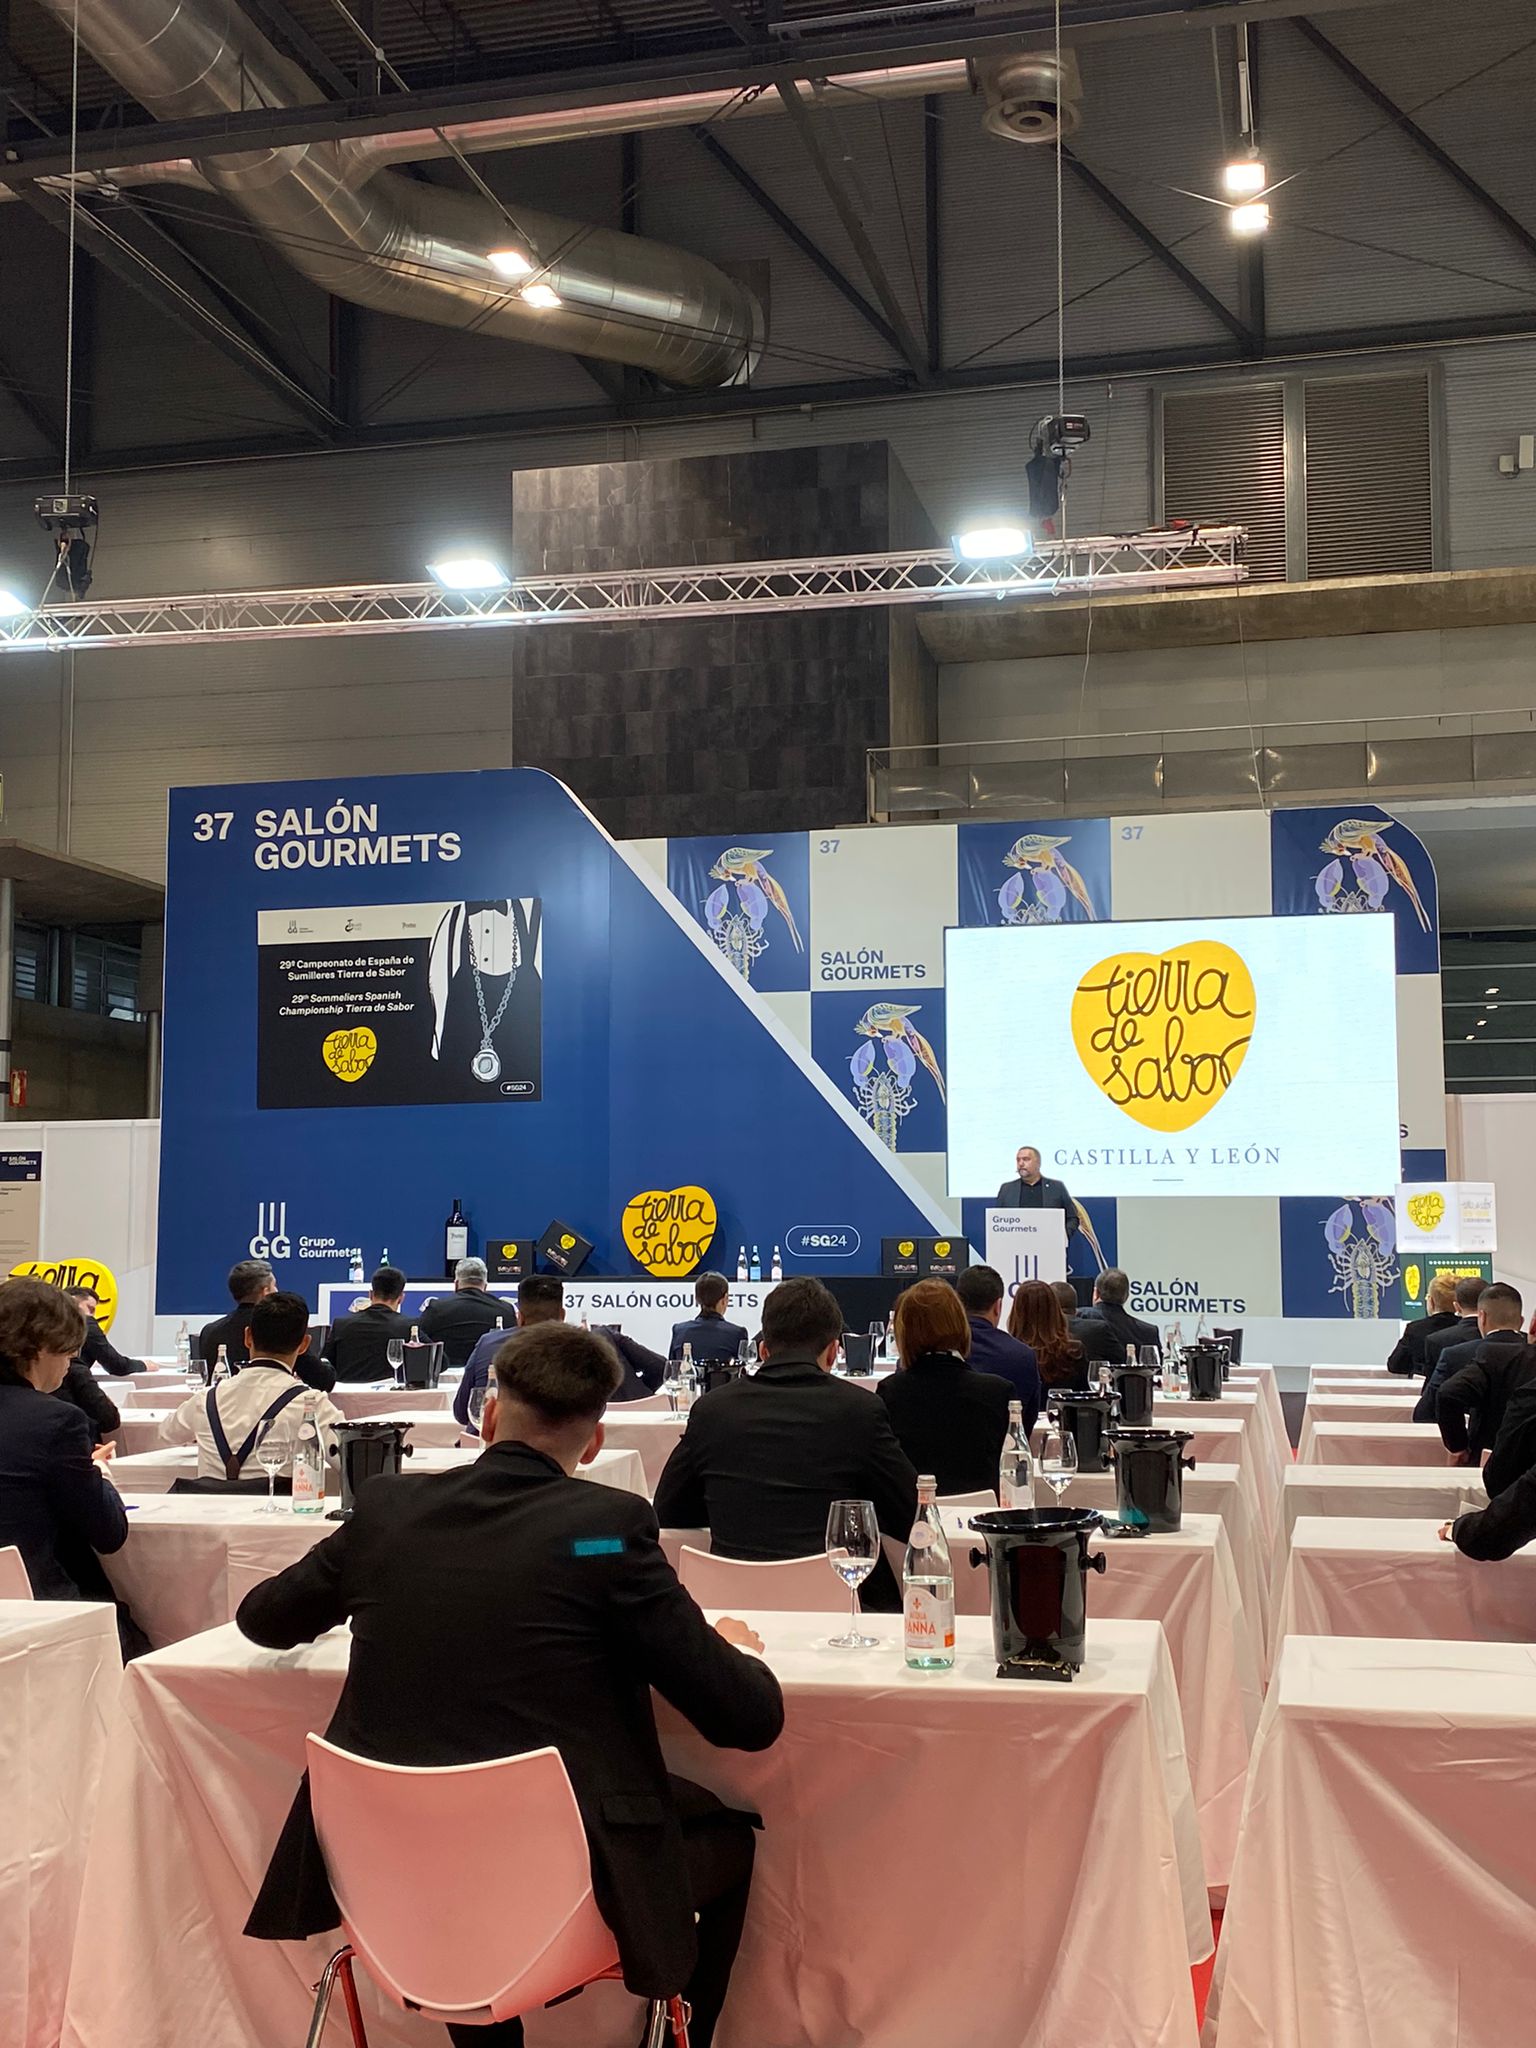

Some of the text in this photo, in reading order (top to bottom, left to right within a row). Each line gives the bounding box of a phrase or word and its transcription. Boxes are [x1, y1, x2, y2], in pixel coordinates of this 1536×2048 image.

[193, 798, 378, 841] 37 SALÓN
[1121, 826, 1144, 841] 37
[254, 832, 462, 871] GOURMETS
[819, 839, 841, 854] 37
[296, 957, 354, 971] Campeonato
[354, 957, 367, 967] de
[367, 955, 401, 968] España
[402, 955, 415, 965] de
[820, 946, 884, 965] SALÓN
[287, 967, 407, 982] Sumilleres Tierra de Sabor
[821, 964, 926, 981] GOURMETS
[310, 992, 364, 1003] Sommeliers
[364, 990, 402, 1001] Spanish
[1076, 959, 1252, 1018] tierra
[278, 1001, 415, 1016] Championship Tierra de Sabor
[1091, 1014, 1144, 1053] de
[1102, 1015, 1252, 1106] sabor
[1053, 1142, 1281, 1165] CASTILLA Y LEÓN
[627, 1194, 715, 1226] tierra
[992, 1216, 1021, 1224] Grupo
[632, 1222, 660, 1239] de
[992, 1225, 1038, 1233] Gourmets
[299, 1236, 335, 1248] Grupo
[637, 1222, 714, 1267] sabor
[801, 1234, 848, 1247] #SG24
[1130, 1277, 1199, 1296] SALÓN
[564, 1291, 759, 1308] 37 SALÓN GOUETS
[1130, 1298, 1246, 1314] GOURMETS
[904, 1620, 936, 1635] ANNA
